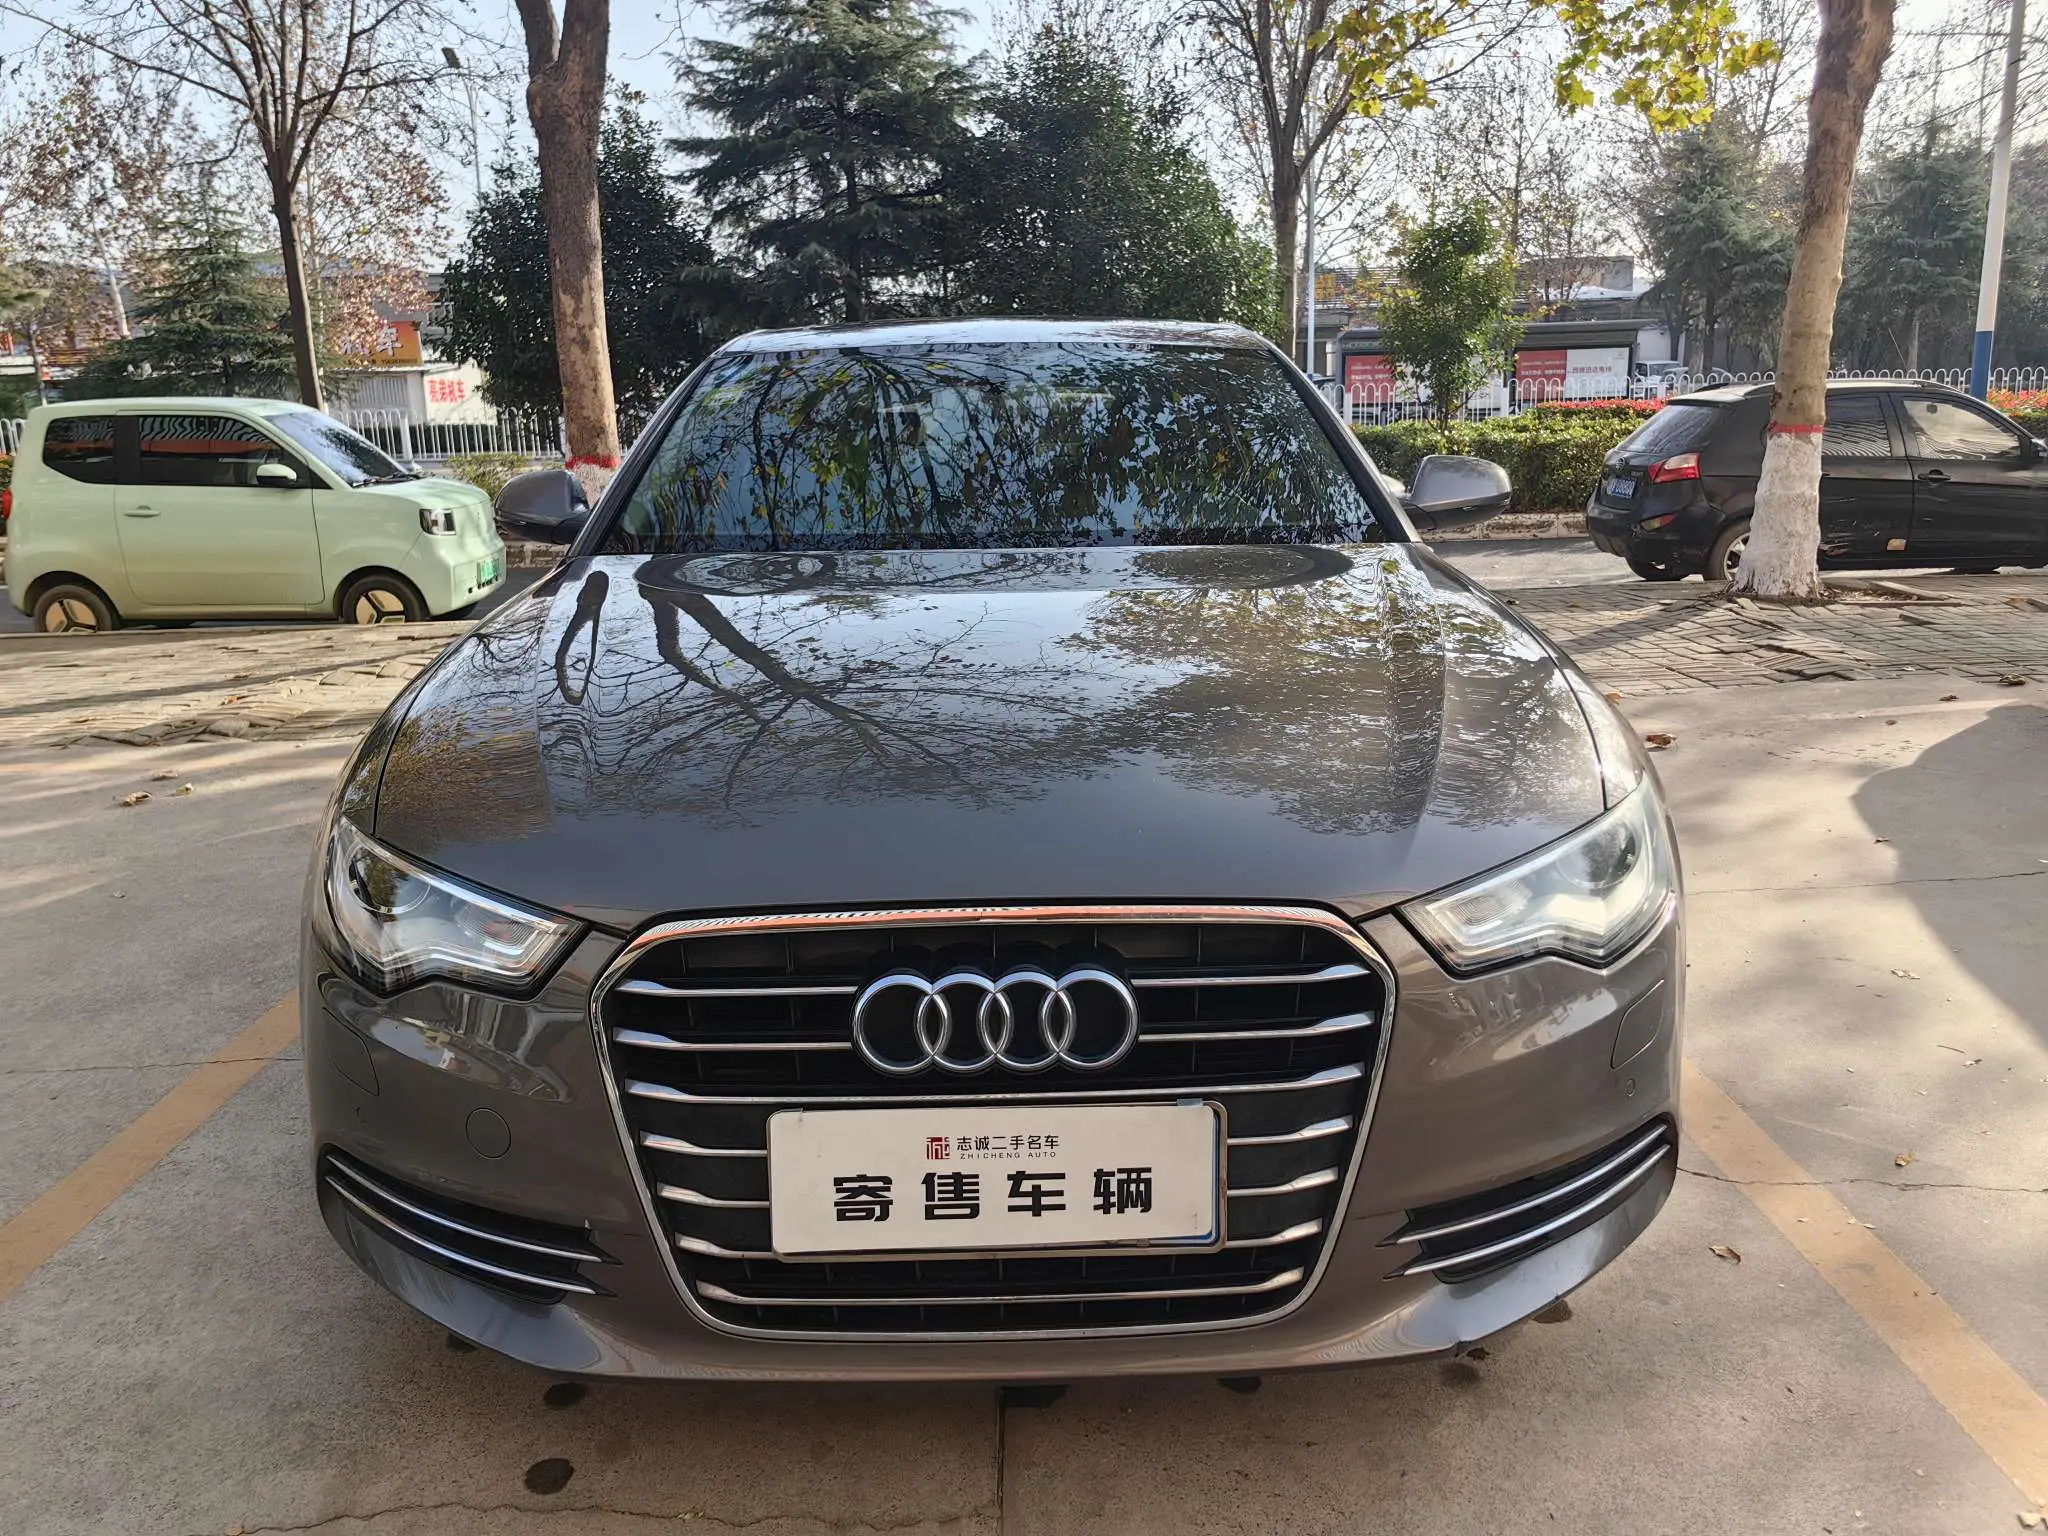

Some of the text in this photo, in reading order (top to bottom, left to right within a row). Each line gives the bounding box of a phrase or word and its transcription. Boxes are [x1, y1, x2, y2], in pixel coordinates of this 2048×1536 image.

[956, 1133, 1060, 1151] 志诚二手名车
[960, 1151, 1057, 1160] ZHICHENG AUTO
[833, 1167, 1153, 1222] 寄售车辆
